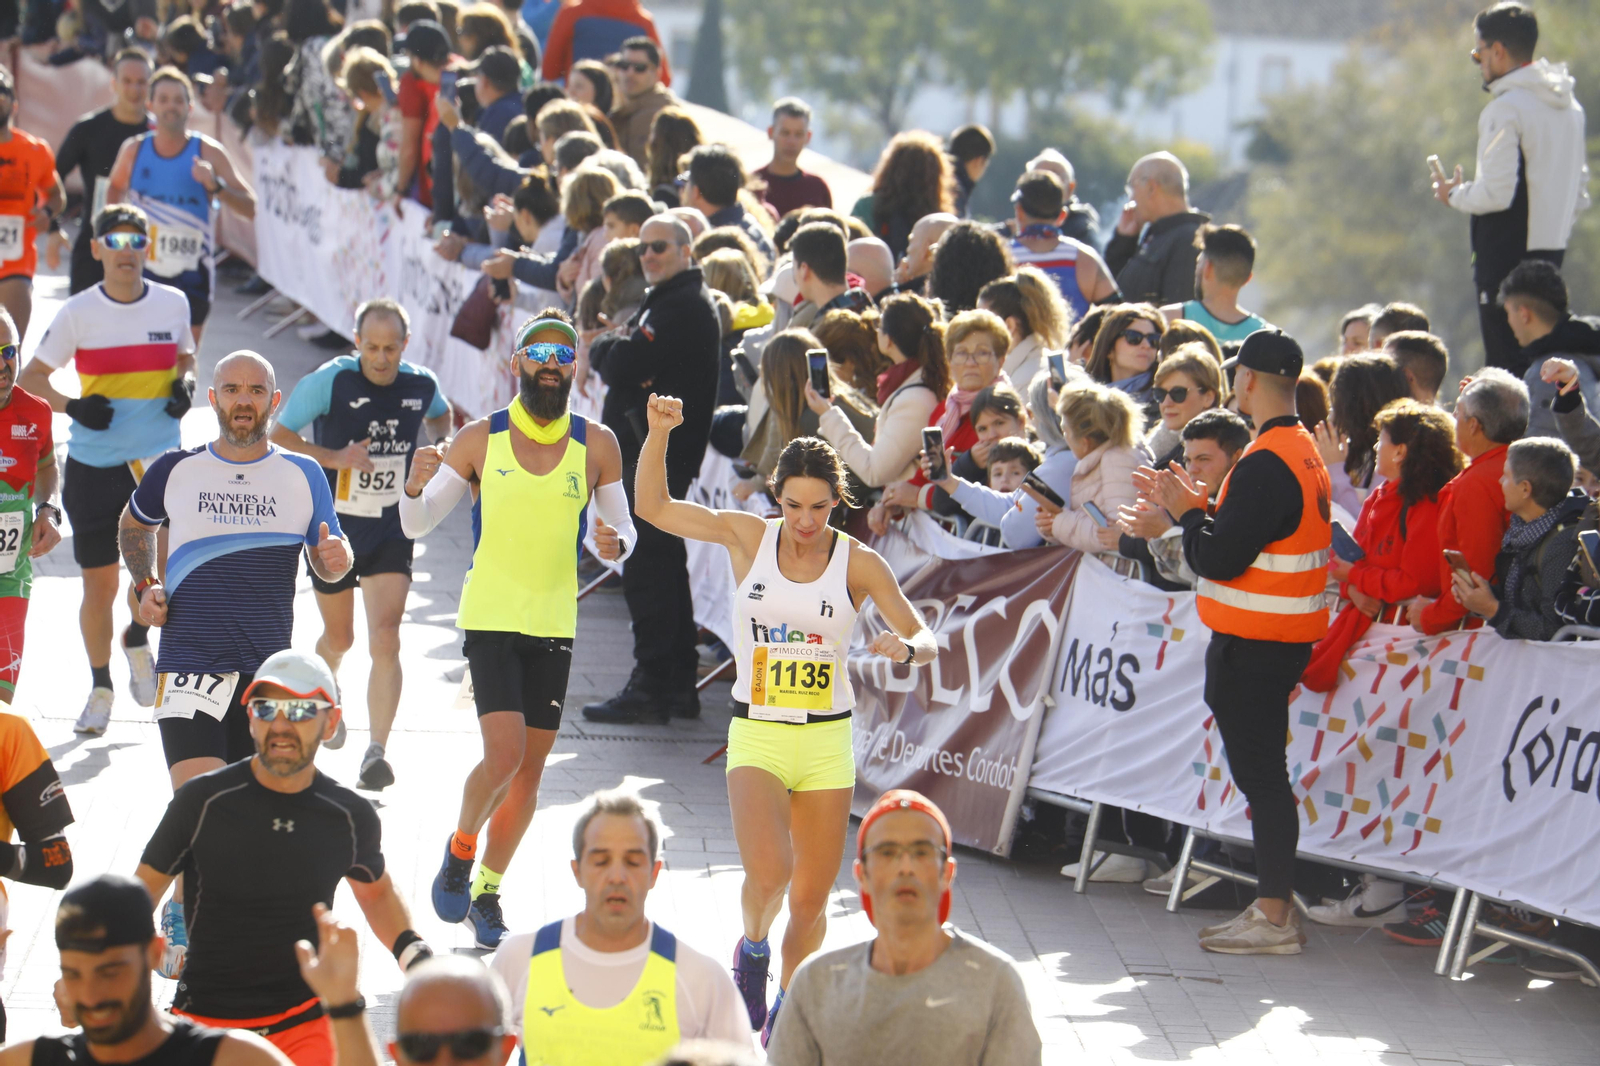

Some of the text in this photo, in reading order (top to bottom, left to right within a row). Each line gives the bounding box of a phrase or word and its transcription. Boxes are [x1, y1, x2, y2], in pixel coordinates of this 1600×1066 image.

[359, 471, 395, 490] 952
[198, 501, 276, 517] PALMERA
[199, 492, 276, 505] RUNNERS LA
[780, 648, 812, 657] IMDECO
[770, 660, 831, 690] 1135
[1060, 621, 1140, 712] Más
[174, 673, 224, 695] 817
[755, 667, 763, 692] CAJÓN
[890, 729, 964, 778] Deportes
